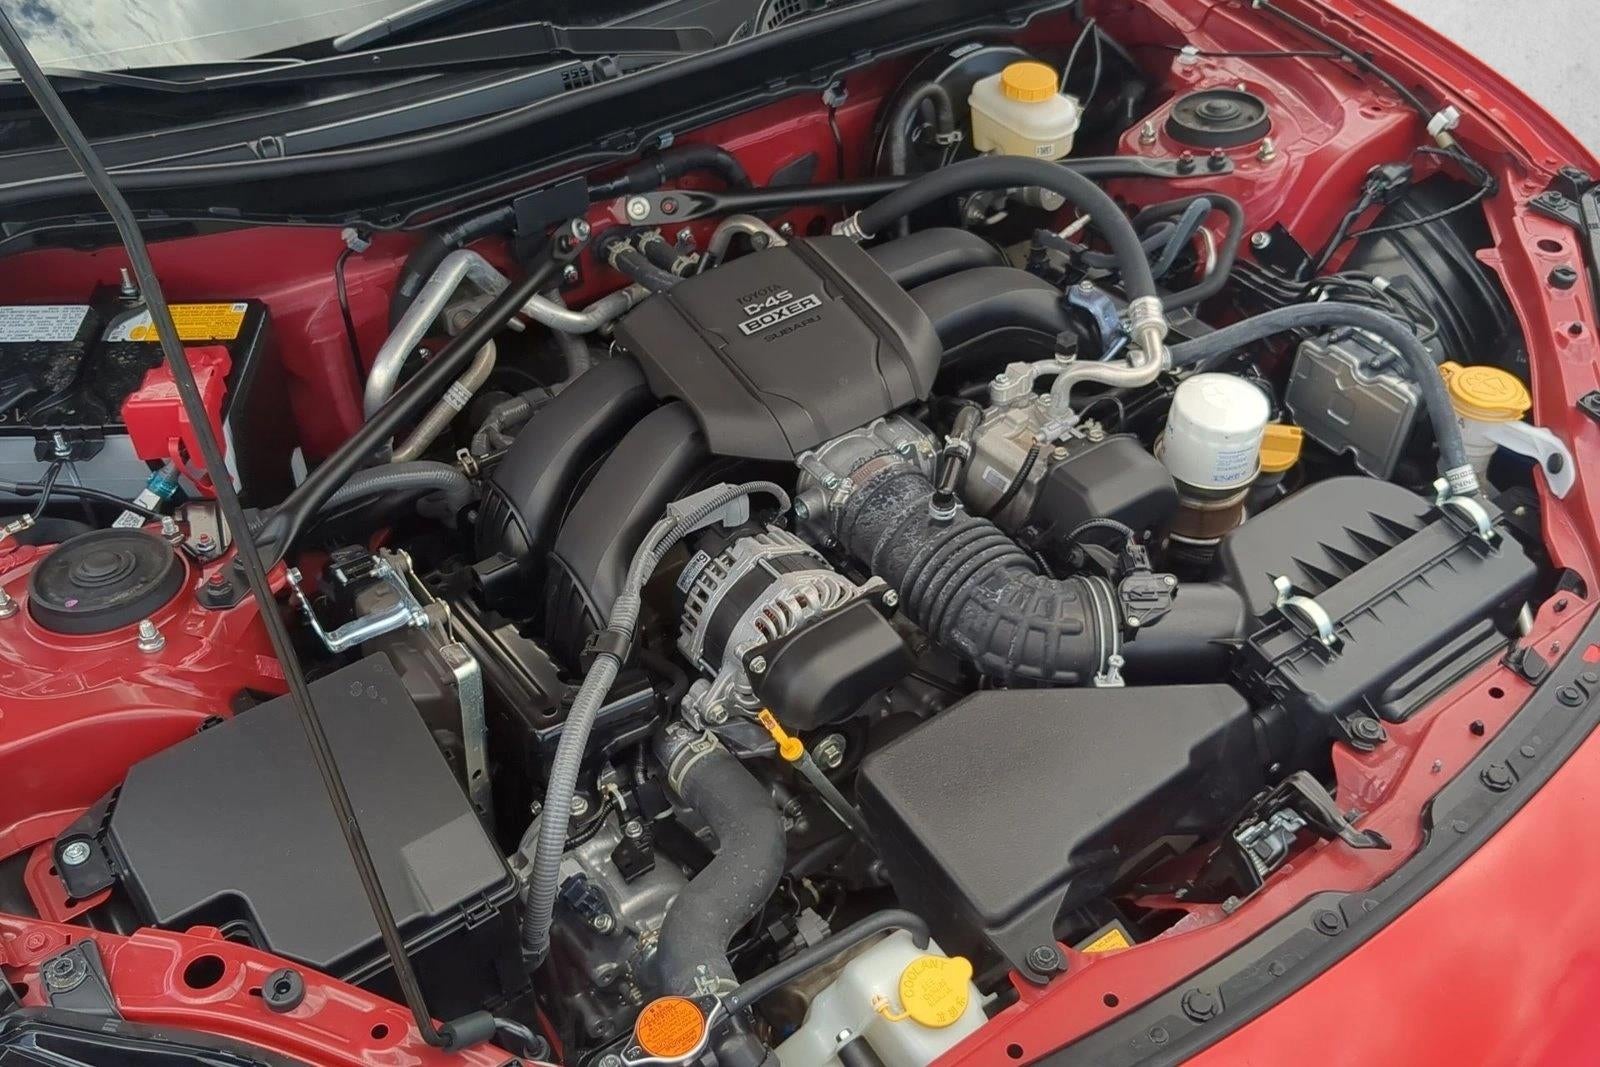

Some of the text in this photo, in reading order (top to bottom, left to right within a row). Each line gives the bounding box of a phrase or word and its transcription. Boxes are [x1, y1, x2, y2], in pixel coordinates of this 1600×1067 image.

[744, 289, 793, 315] D-4S
[744, 298, 817, 331] BOXER
[763, 315, 822, 342] SUBARU
[904, 959, 949, 998] COOLANT
